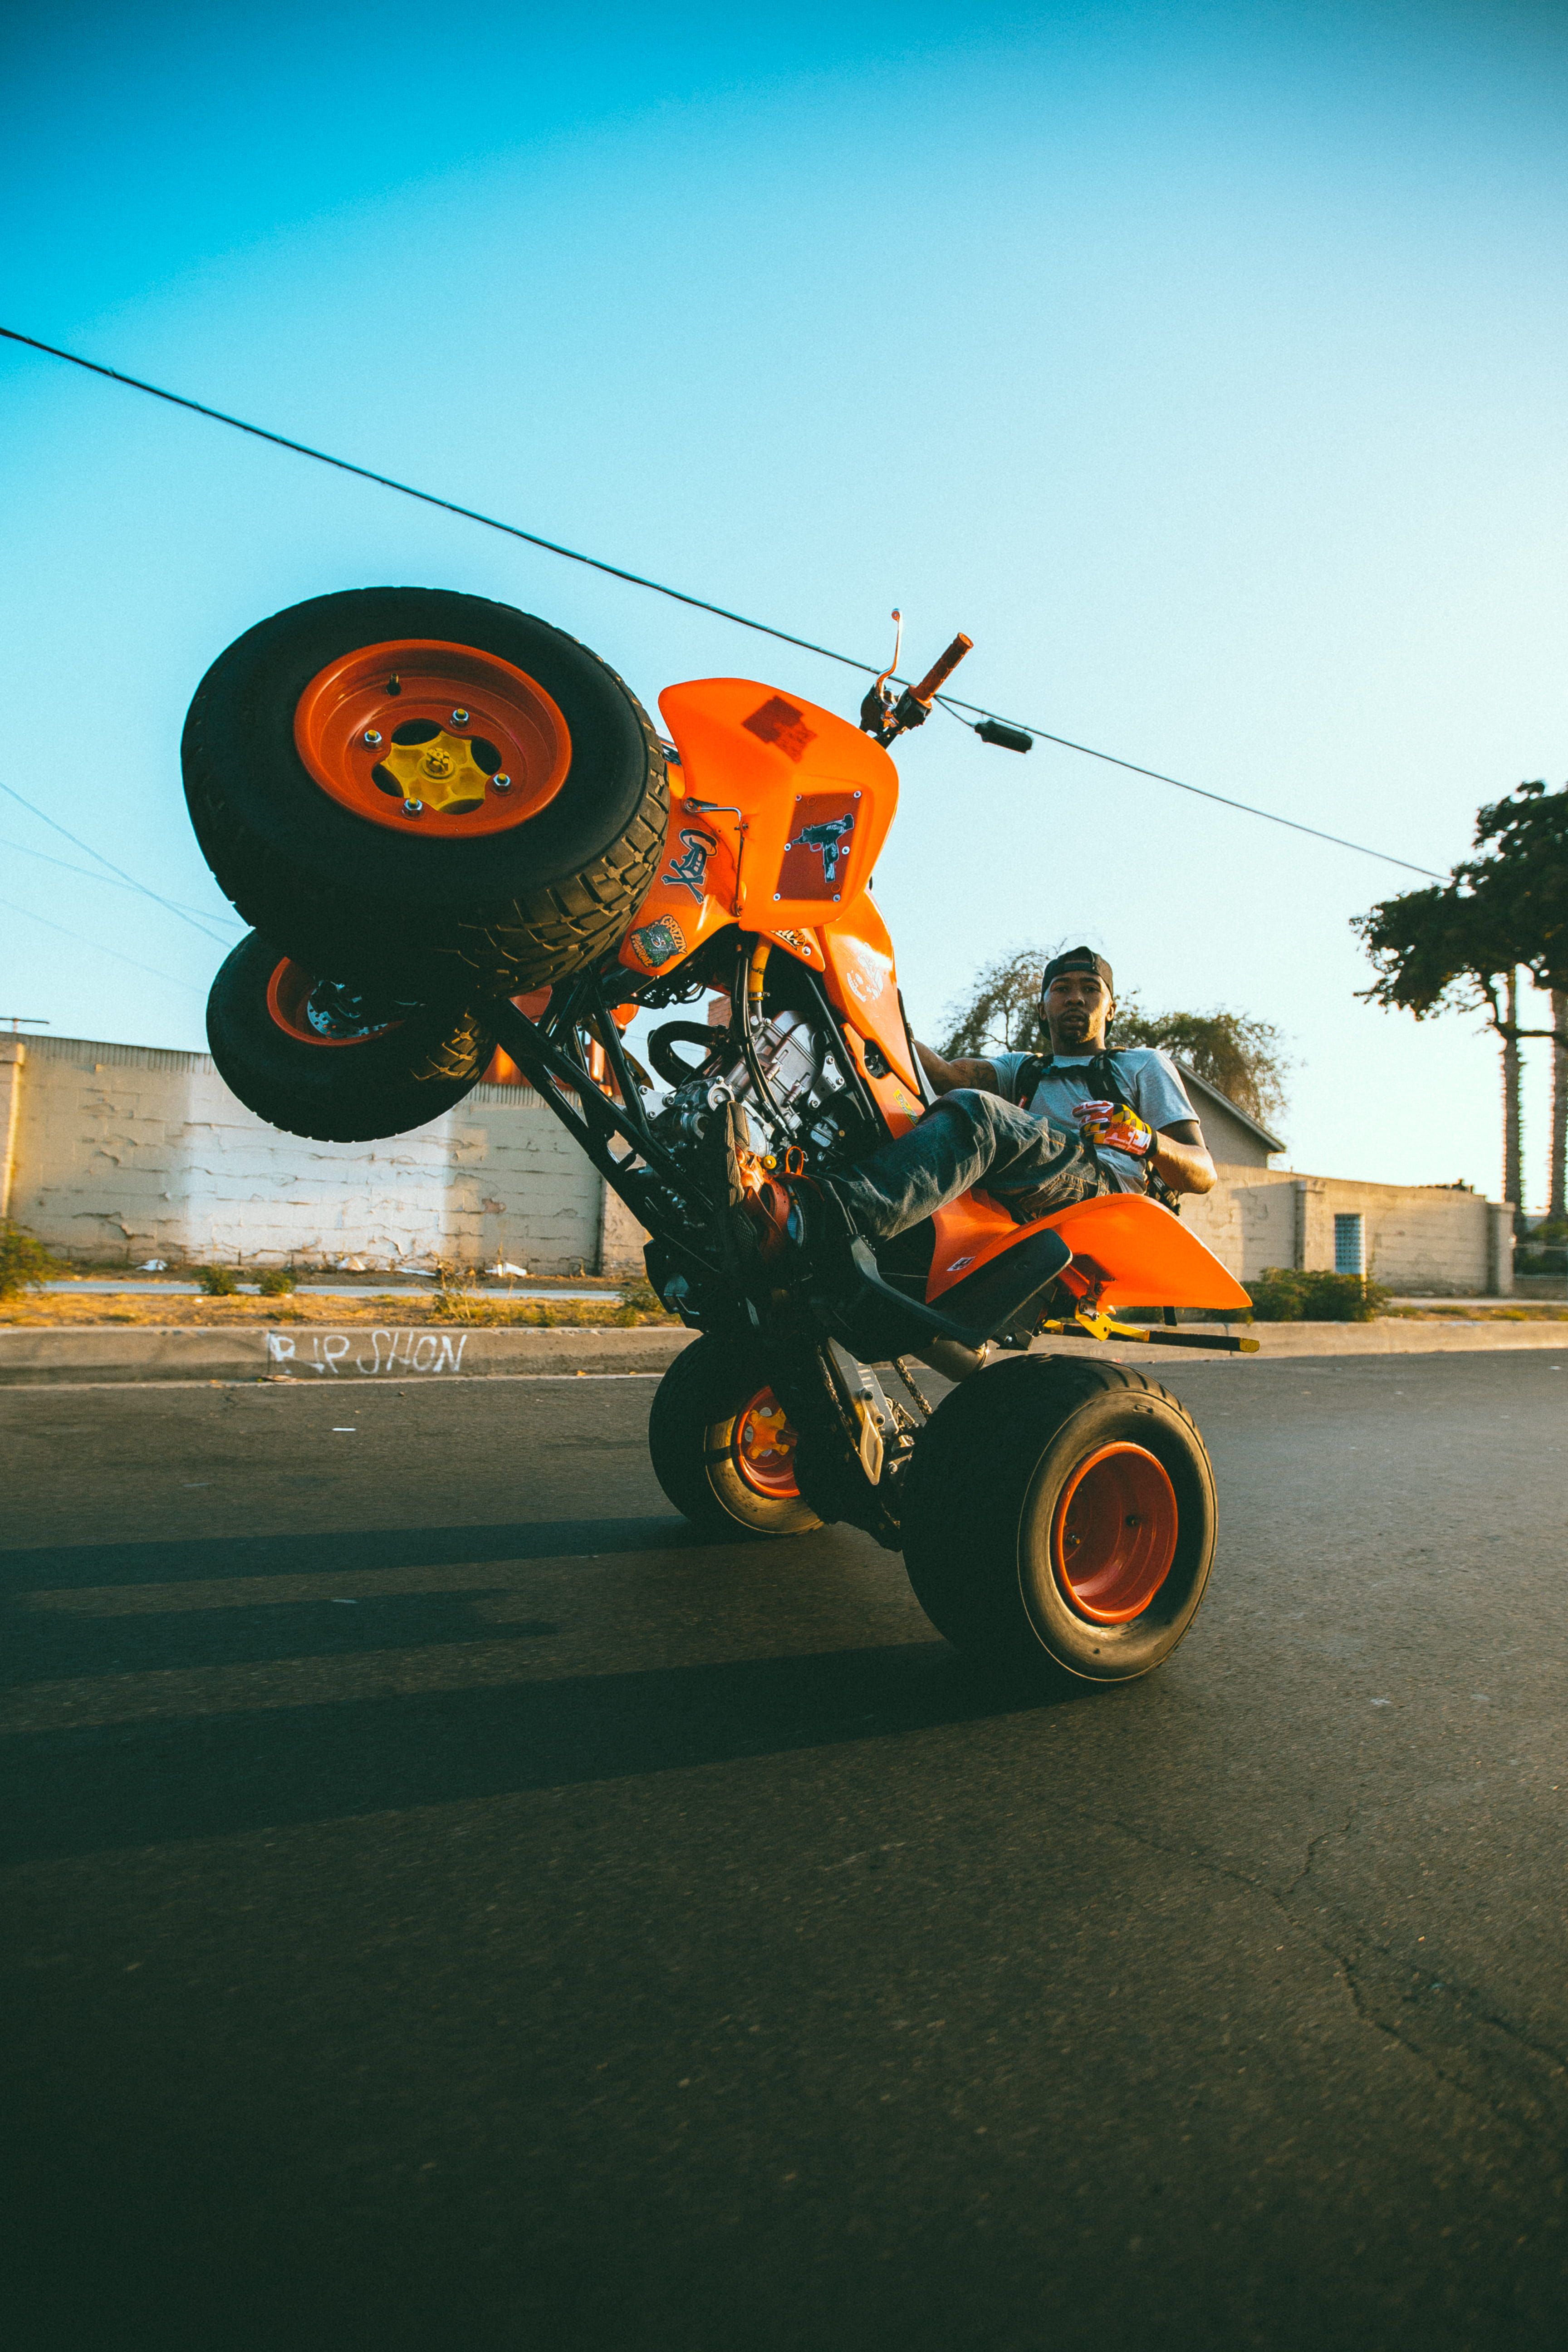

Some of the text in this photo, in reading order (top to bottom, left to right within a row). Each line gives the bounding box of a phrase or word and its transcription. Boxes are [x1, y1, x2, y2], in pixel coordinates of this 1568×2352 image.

[660, 915, 687, 955] GRIZZLY
[265, 1330, 467, 1374] RIP SHON
